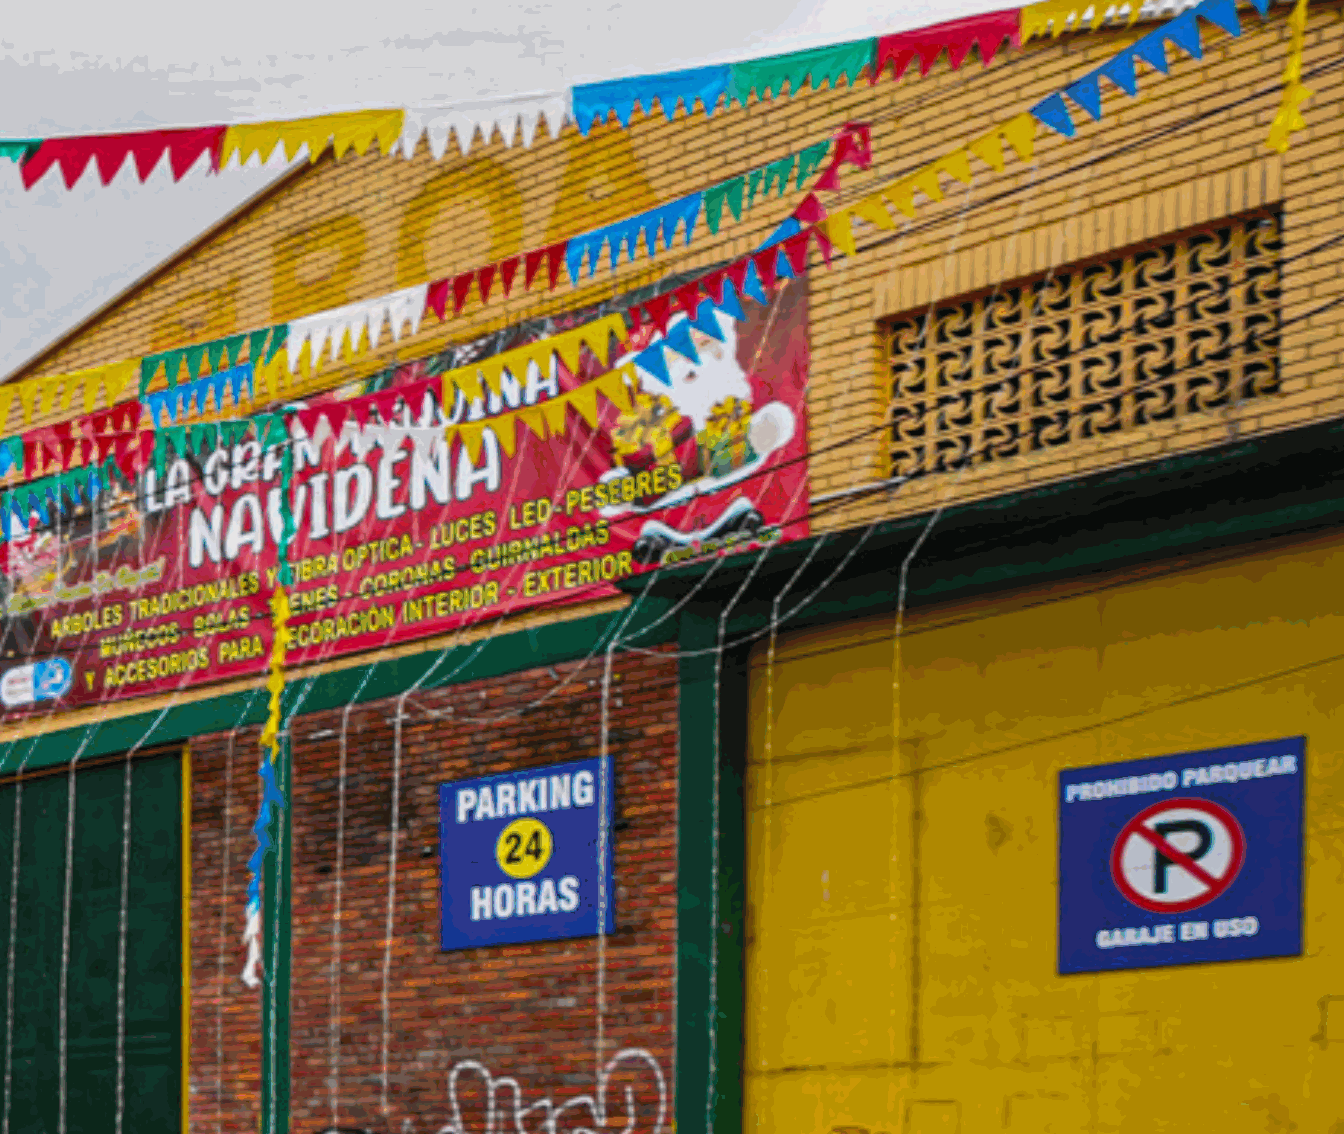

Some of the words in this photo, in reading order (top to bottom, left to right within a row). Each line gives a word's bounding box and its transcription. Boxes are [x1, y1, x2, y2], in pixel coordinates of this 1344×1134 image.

[146, 459, 192, 512] LA
[205, 424, 319, 494] GRAN
[51, 604, 123, 639] ARBOLES
[130, 571, 259, 619] TRADICIONALES
[266, 566, 278, 588] Y
[430, 511, 496, 550] LUCES
[193, 606, 250, 638] BOLAS
[359, 556, 456, 599] CORONAS
[470, 520, 609, 574] GUIRNALDAS
[84, 671, 95, 691] Y
[103, 648, 210, 688] ACCESORIOS
[219, 636, 264, 664] PARA
[402, 580, 499, 623] INTERIOR
[523, 550, 632, 597] EXTERIOR
[456, 770, 595, 823] PARKING
[1065, 771, 1179, 803] PROHIBIDO
[1181, 755, 1298, 788] PARQUEAR
[505, 829, 544, 864] 24
[471, 875, 580, 921] HORAS
[1095, 924, 1176, 949] GARAJE
[1179, 921, 1209, 942] EN
[1212, 916, 1260, 938] USO
